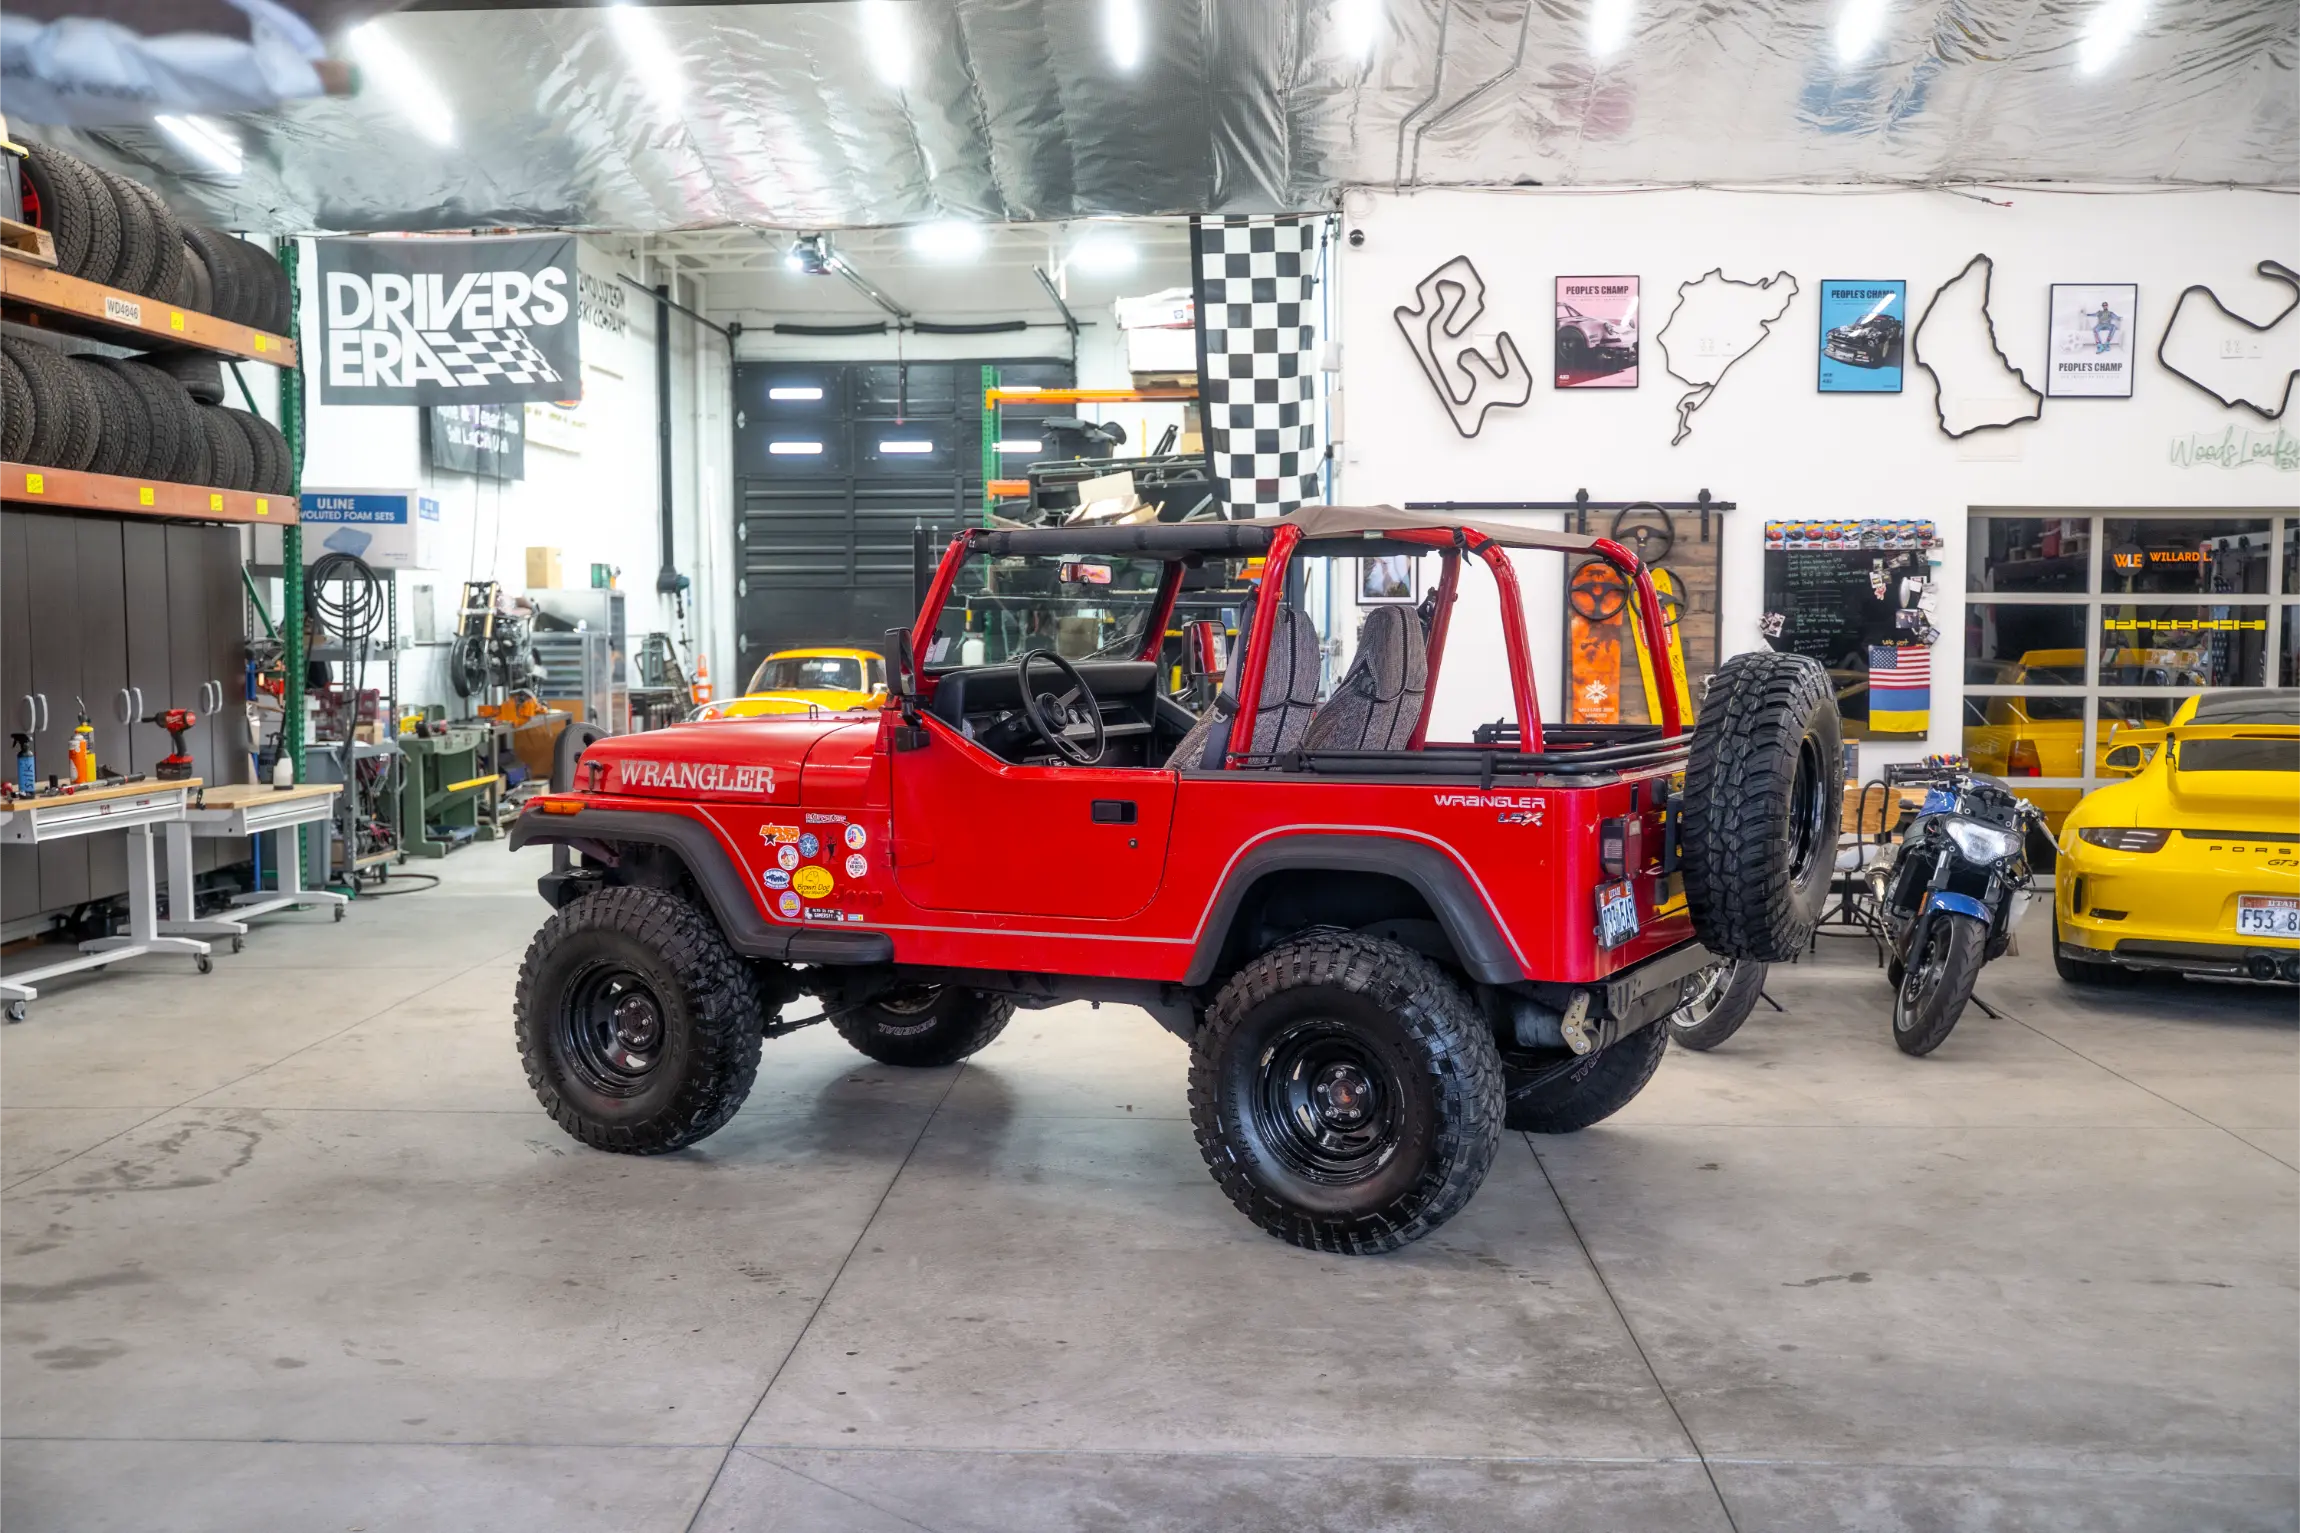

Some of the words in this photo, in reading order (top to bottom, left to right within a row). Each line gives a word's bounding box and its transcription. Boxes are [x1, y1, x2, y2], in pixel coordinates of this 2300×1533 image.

[1566, 285, 1600, 295] PEOPLE'S
[1601, 285, 1629, 295] CHAMP
[1831, 289, 1865, 299] PEOPLE'S
[326, 266, 569, 330] DRIVERS
[329, 329, 460, 387] ERA
[2058, 362, 2093, 372] PEOPLE'S
[2094, 362, 2123, 372] CHAMP
[2170, 425, 2239, 467] Woods
[316, 497, 355, 510] ULINE
[343, 511, 372, 521] FOAM
[374, 511, 395, 521] SETS
[2113, 553, 2143, 568] WLE
[2150, 552, 2200, 562] WILLARD
[2203, 552, 2212, 562] L.
[620, 759, 776, 793] WRANGLER
[1497, 811, 1544, 827] LSX
[2267, 859, 2299, 867] GT3
[817, 884, 830, 892] Dog
[2267, 900, 2297, 908] UTAH
[2241, 909, 2274, 929] F53
[2287, 911, 2300, 931] 8
